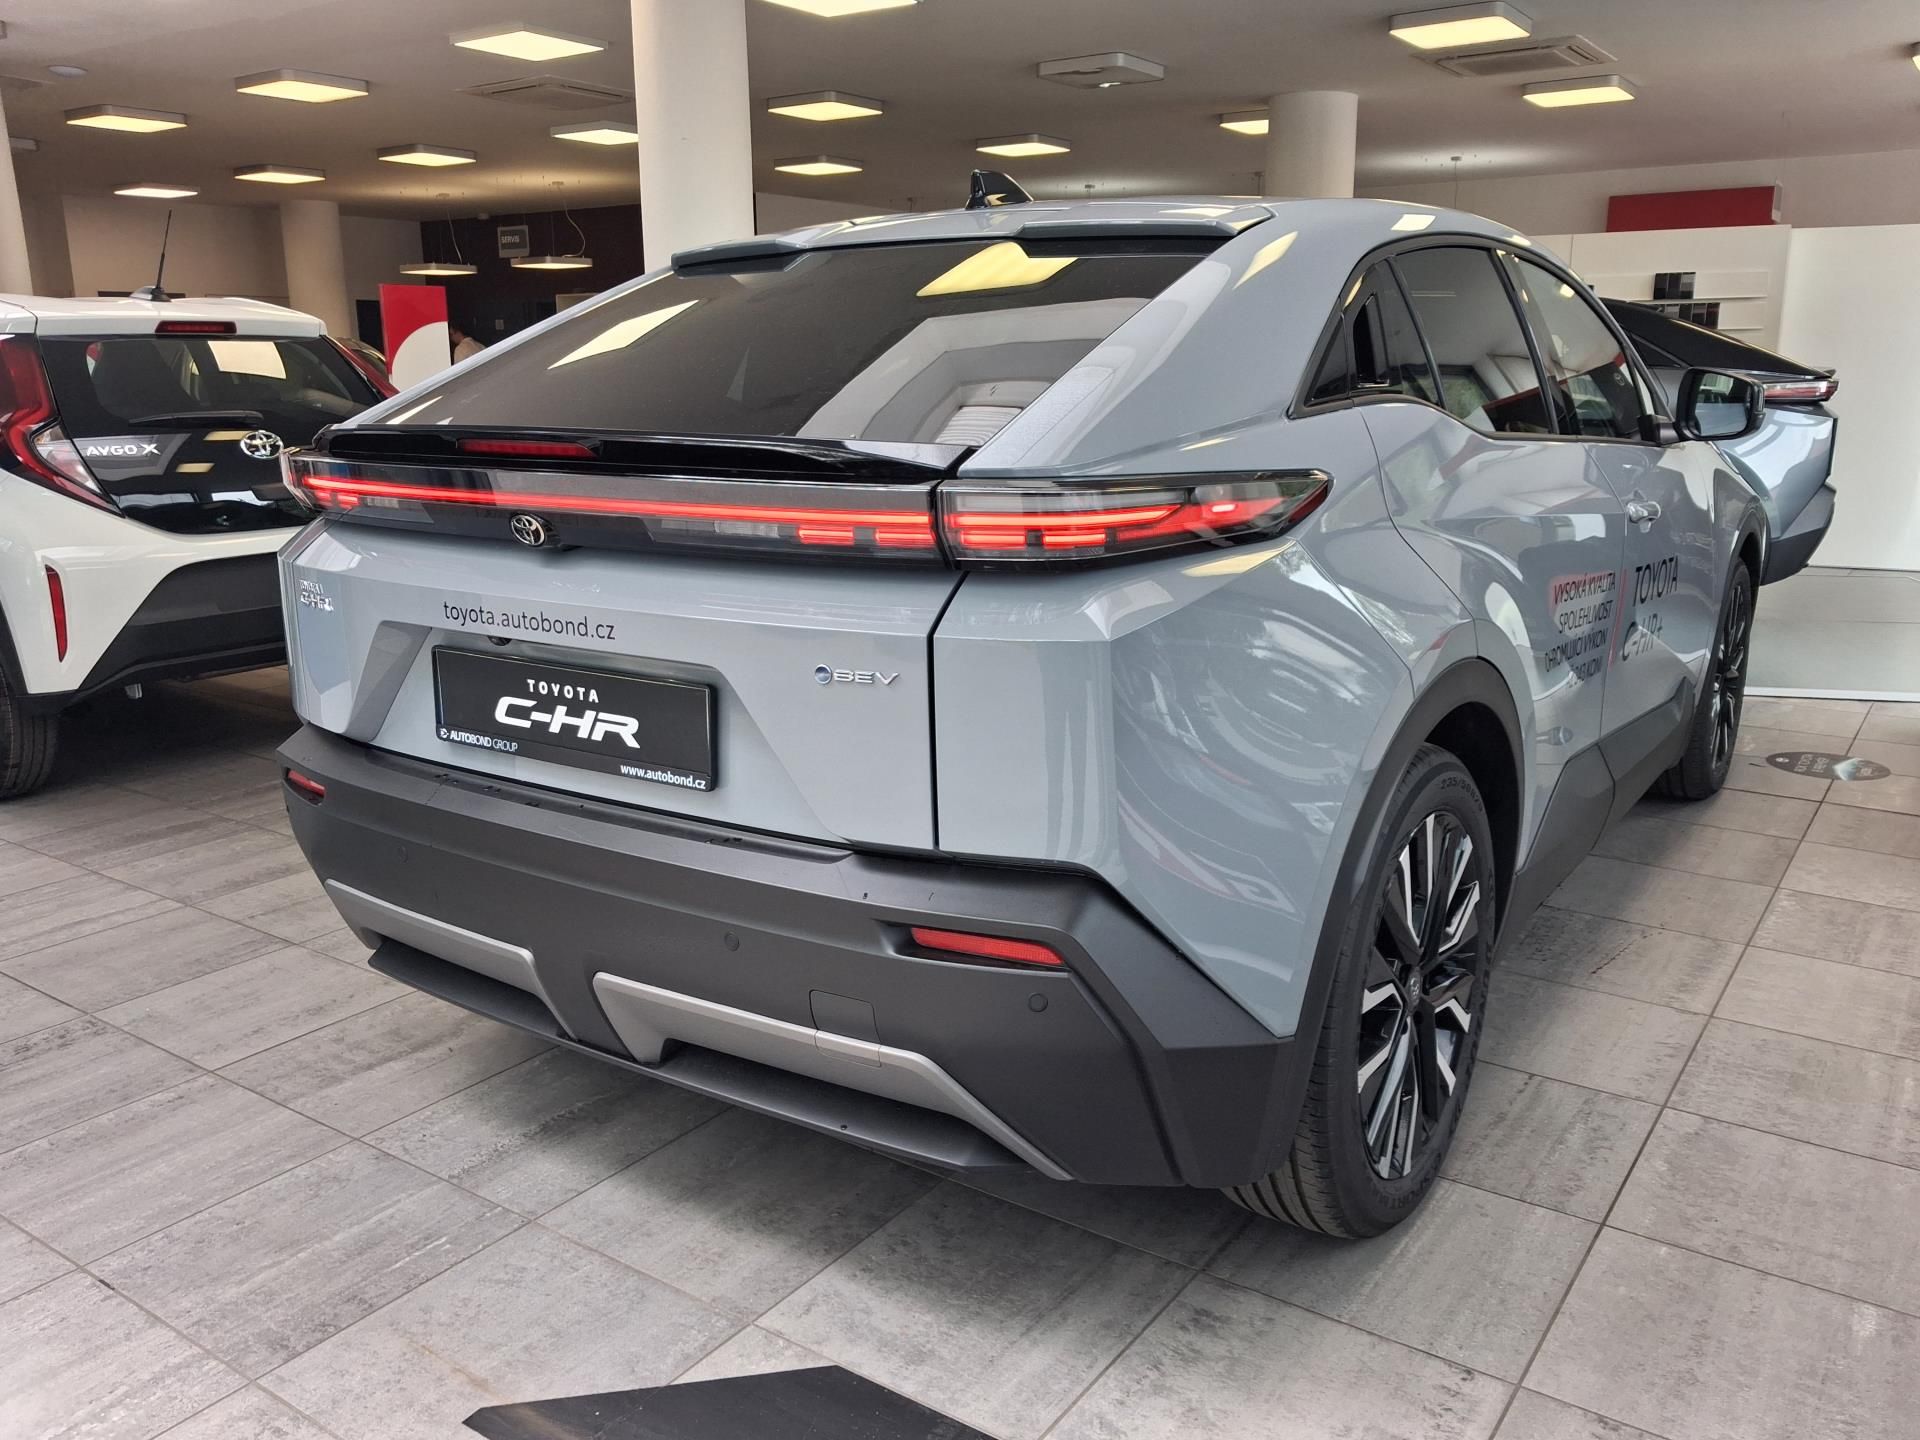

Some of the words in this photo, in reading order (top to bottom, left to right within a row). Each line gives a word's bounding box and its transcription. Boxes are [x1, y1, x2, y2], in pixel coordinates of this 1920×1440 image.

[86, 445, 138, 457] AYGO
[140, 443, 161, 456] X
[1632, 554, 1679, 607] TOYOTA
[443, 601, 616, 641] toyota.autobond.cz
[1559, 599, 1614, 634] SPOLEHLIVOST
[527, 679, 600, 703] TOYOTA
[495, 696, 641, 749] C-HR
[450, 730, 492, 748] AUTOBOND
[492, 739, 518, 752] GROUP
[620, 764, 707, 790] www.autobond.cz
